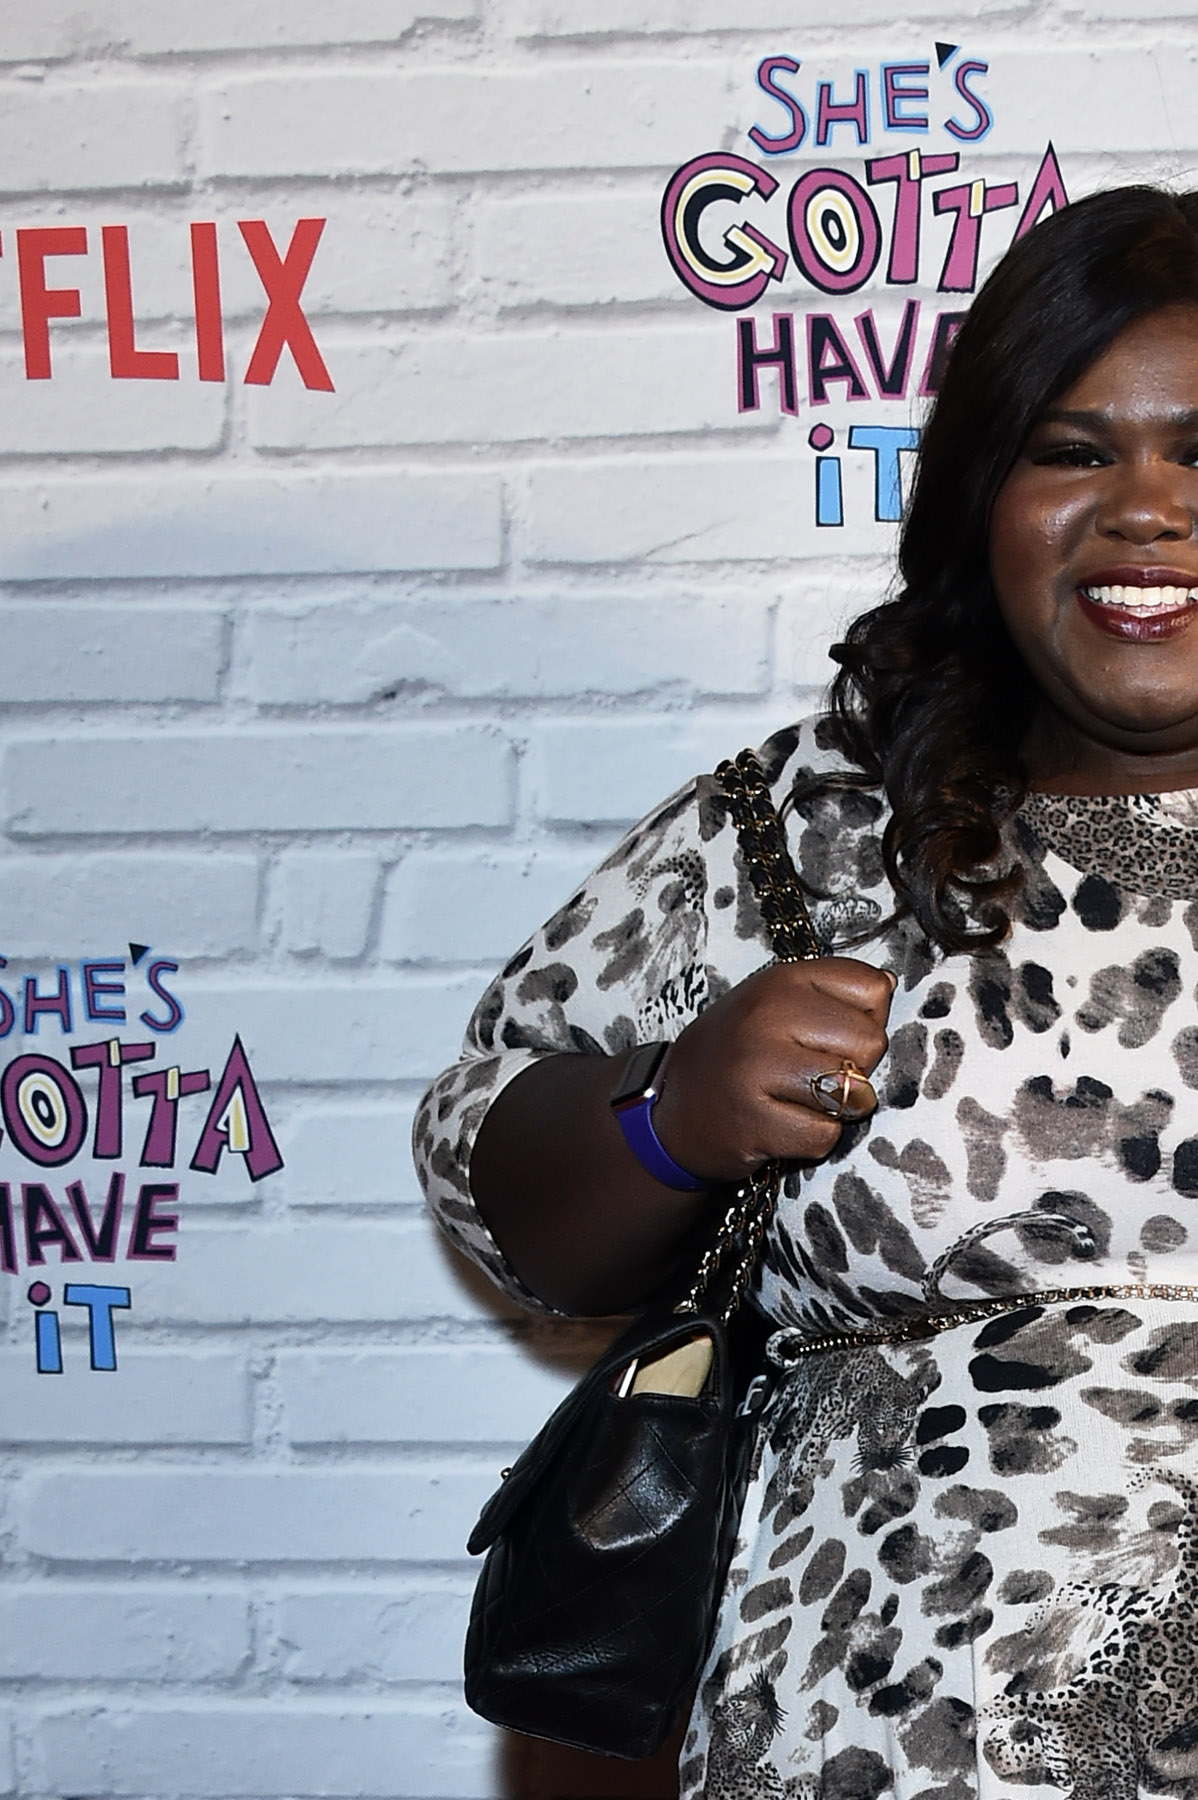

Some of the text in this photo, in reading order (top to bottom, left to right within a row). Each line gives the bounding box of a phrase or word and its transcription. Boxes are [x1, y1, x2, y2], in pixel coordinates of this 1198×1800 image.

[748, 41, 994, 157] SHE'S
[0, 218, 336, 392] FLIX
[0, 942, 184, 1038] HE'S
[0, 1033, 285, 1183] OTTA
